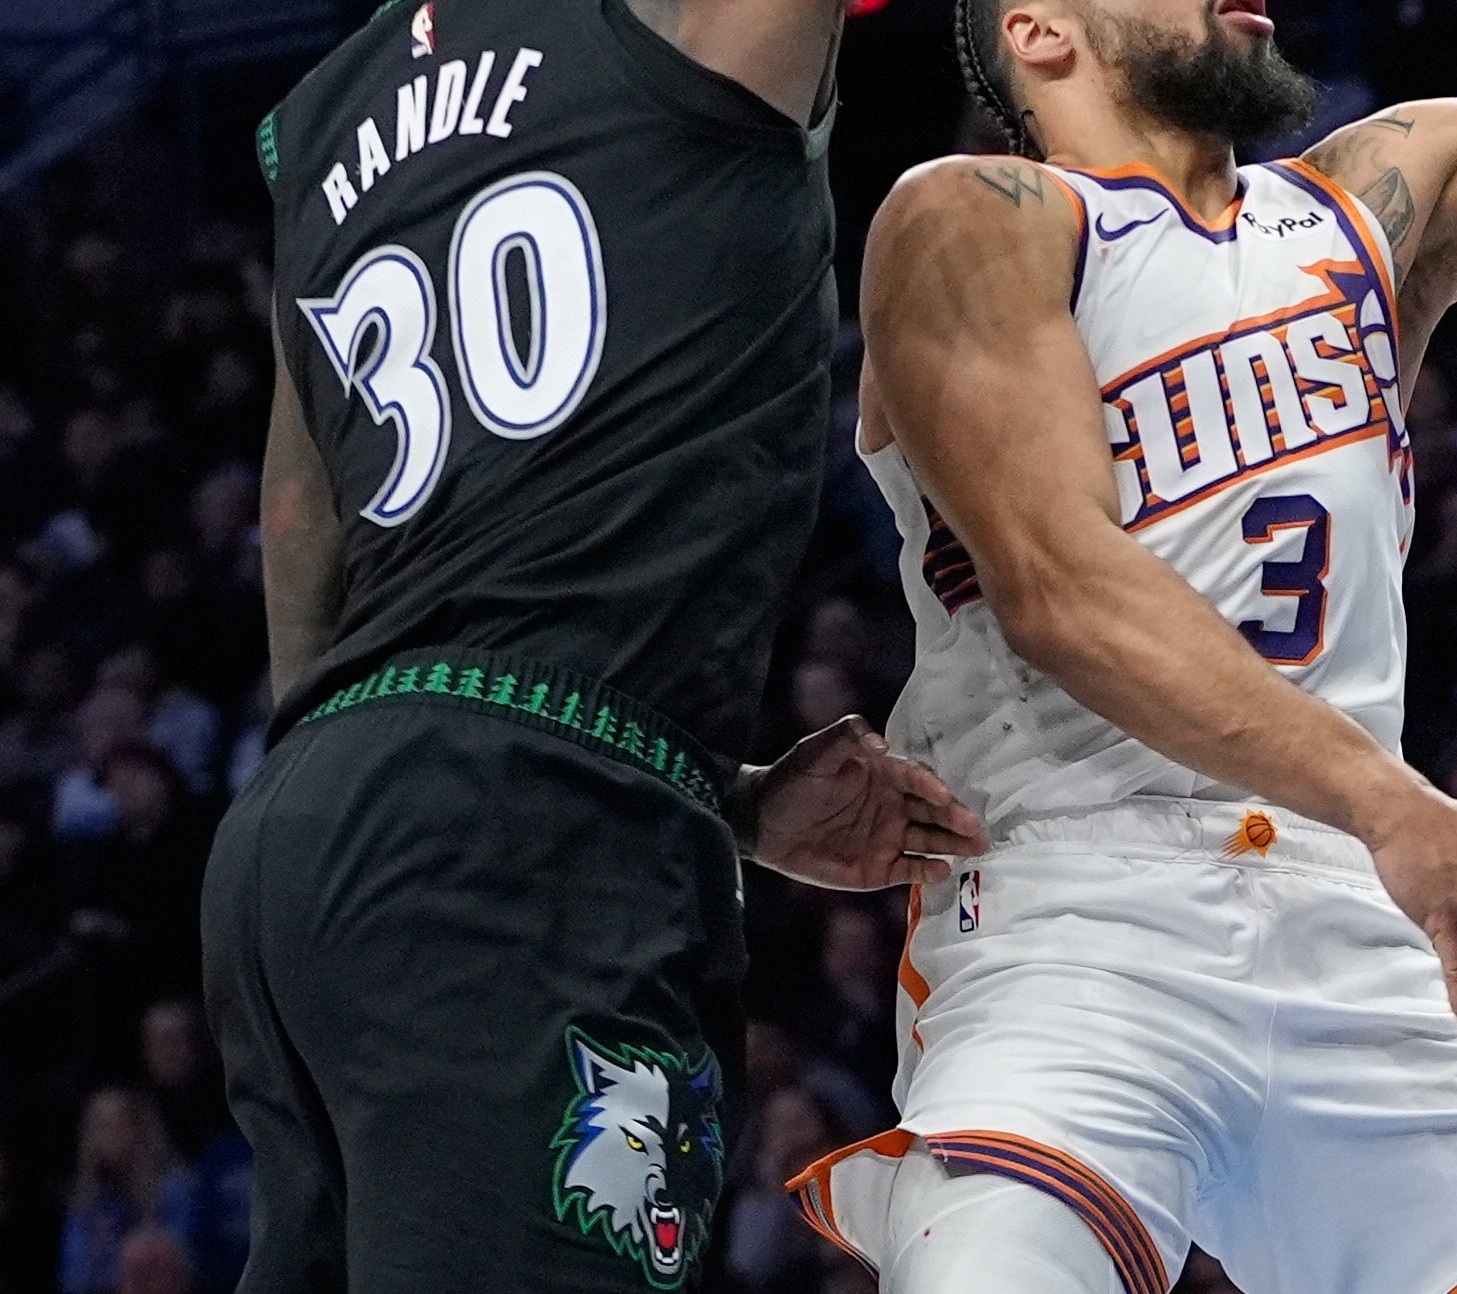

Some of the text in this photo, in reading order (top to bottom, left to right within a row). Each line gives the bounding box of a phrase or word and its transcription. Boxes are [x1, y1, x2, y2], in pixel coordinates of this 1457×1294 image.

[320, 46, 543, 225] RANDLE
[1241, 211, 1324, 238] PayPal
[295, 170, 607, 528] 30
[1241, 494, 1333, 666] 3
